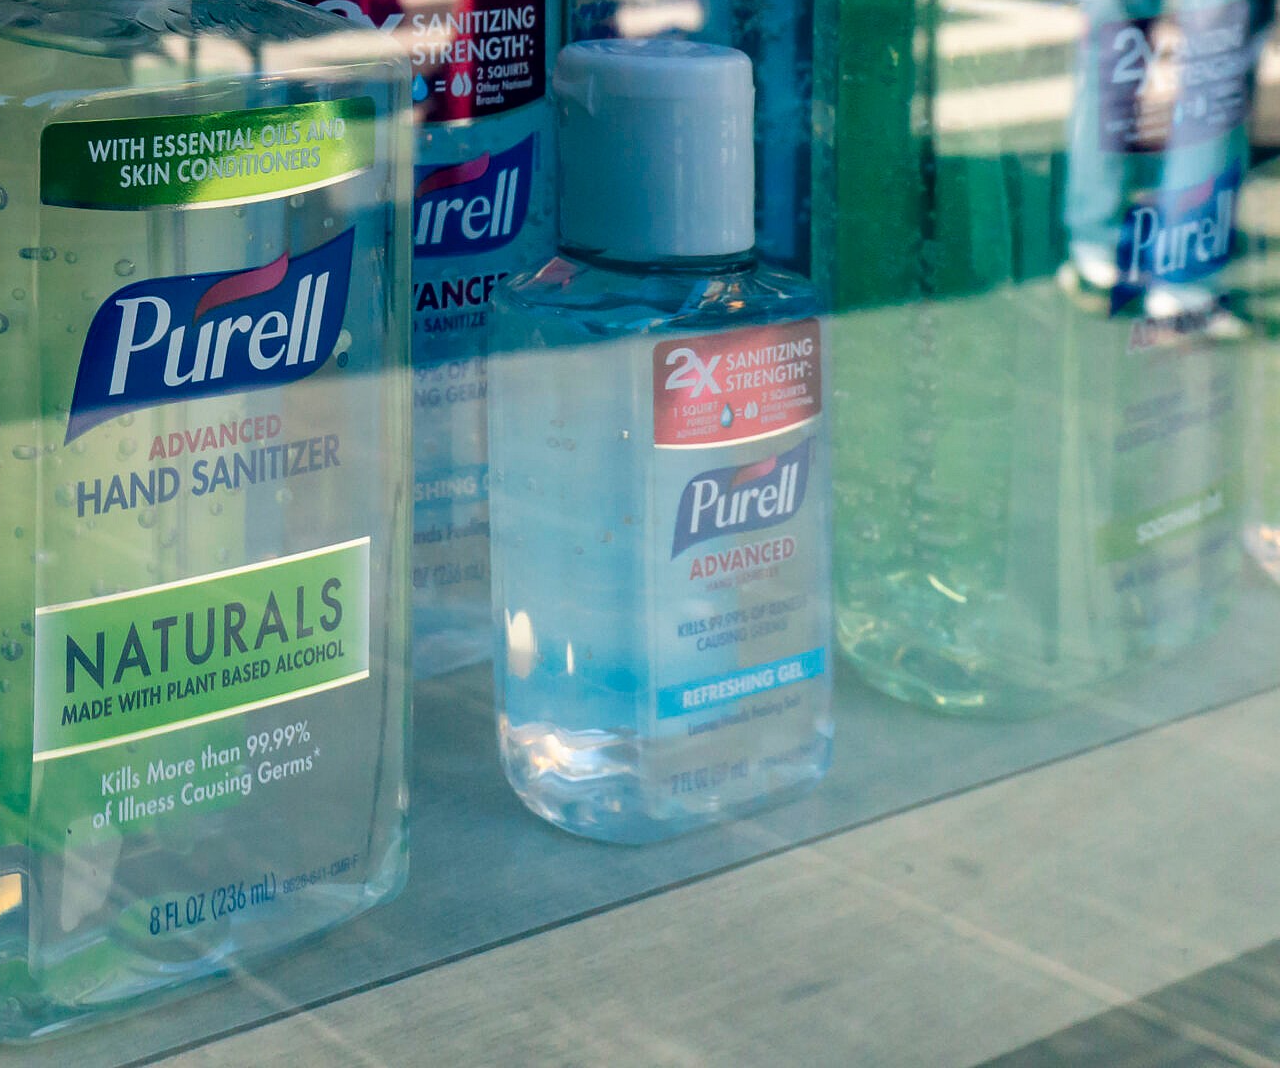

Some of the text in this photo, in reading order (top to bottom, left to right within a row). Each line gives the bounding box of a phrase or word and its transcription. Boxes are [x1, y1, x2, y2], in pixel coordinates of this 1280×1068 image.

[412, 5, 535, 37] SANITIZING
[476, 61, 529, 79] 2 SQUIRTS
[88, 117, 346, 163] WITH ESSENTIAL OILS AND
[120, 146, 321, 188] SKIN CONDITIONERS
[1129, 189, 1233, 284] Purell
[109, 271, 330, 396] Purell
[725, 338, 814, 372] SANITIZING
[148, 414, 282, 462] ADVANCED
[77, 434, 342, 518] HAND SANITIZER
[690, 462, 799, 534] Purell
[689, 538, 795, 581] ADVANCED
[65, 577, 344, 694] NATURALS
[61, 639, 345, 726] MADE WITH PLANT BASED ALCOHOL
[682, 661, 804, 708] REFRESHING GEL
[101, 720, 311, 796] Kills More than 99.99%
[92, 800, 112, 829] of
[118, 793, 175, 824] Illness
[180, 774, 252, 807] Causing
[149, 906, 161, 935] 8
[165, 900, 182, 932] FL
[185, 892, 206, 925] OZ
[211, 881, 247, 920] (236
[250, 872, 277, 906] mL)
